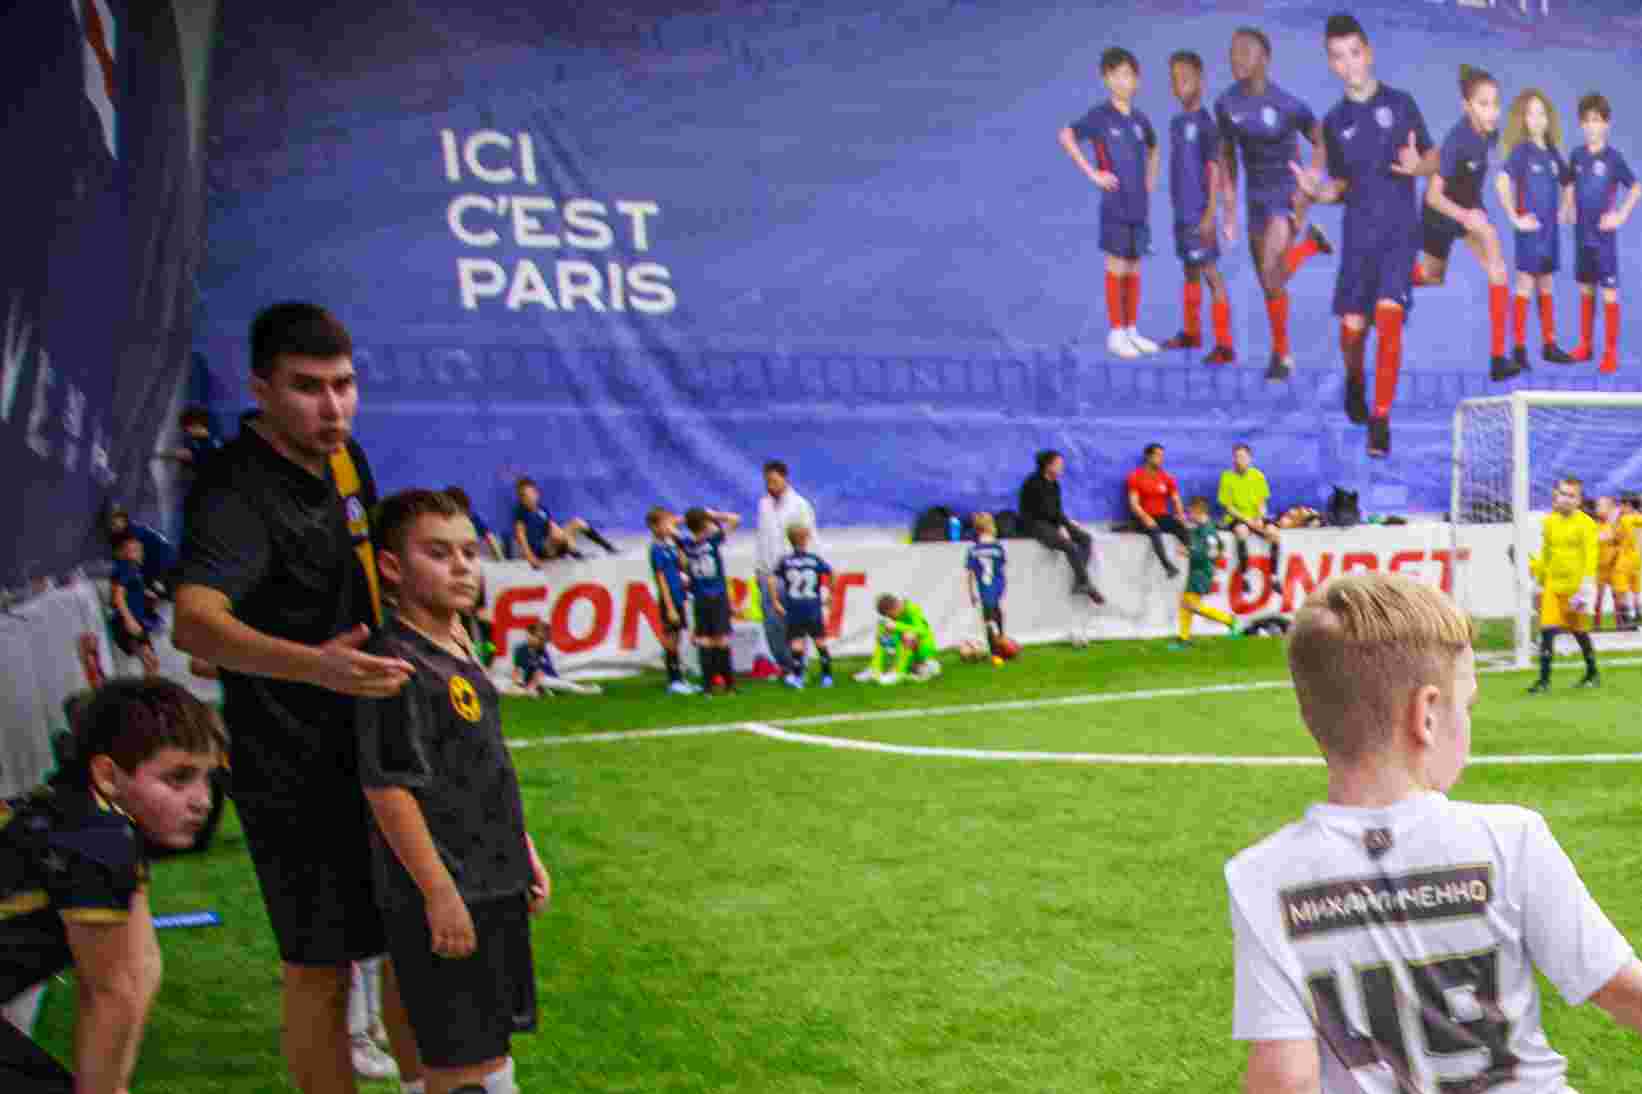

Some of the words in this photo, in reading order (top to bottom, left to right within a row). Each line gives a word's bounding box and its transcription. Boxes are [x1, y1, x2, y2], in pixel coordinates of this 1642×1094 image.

[440, 128, 539, 185] ICI
[448, 193, 660, 251] C'EST
[456, 257, 677, 313] PARIS
[1211, 545, 1472, 616] ONT
[489, 572, 867, 657] FONT
